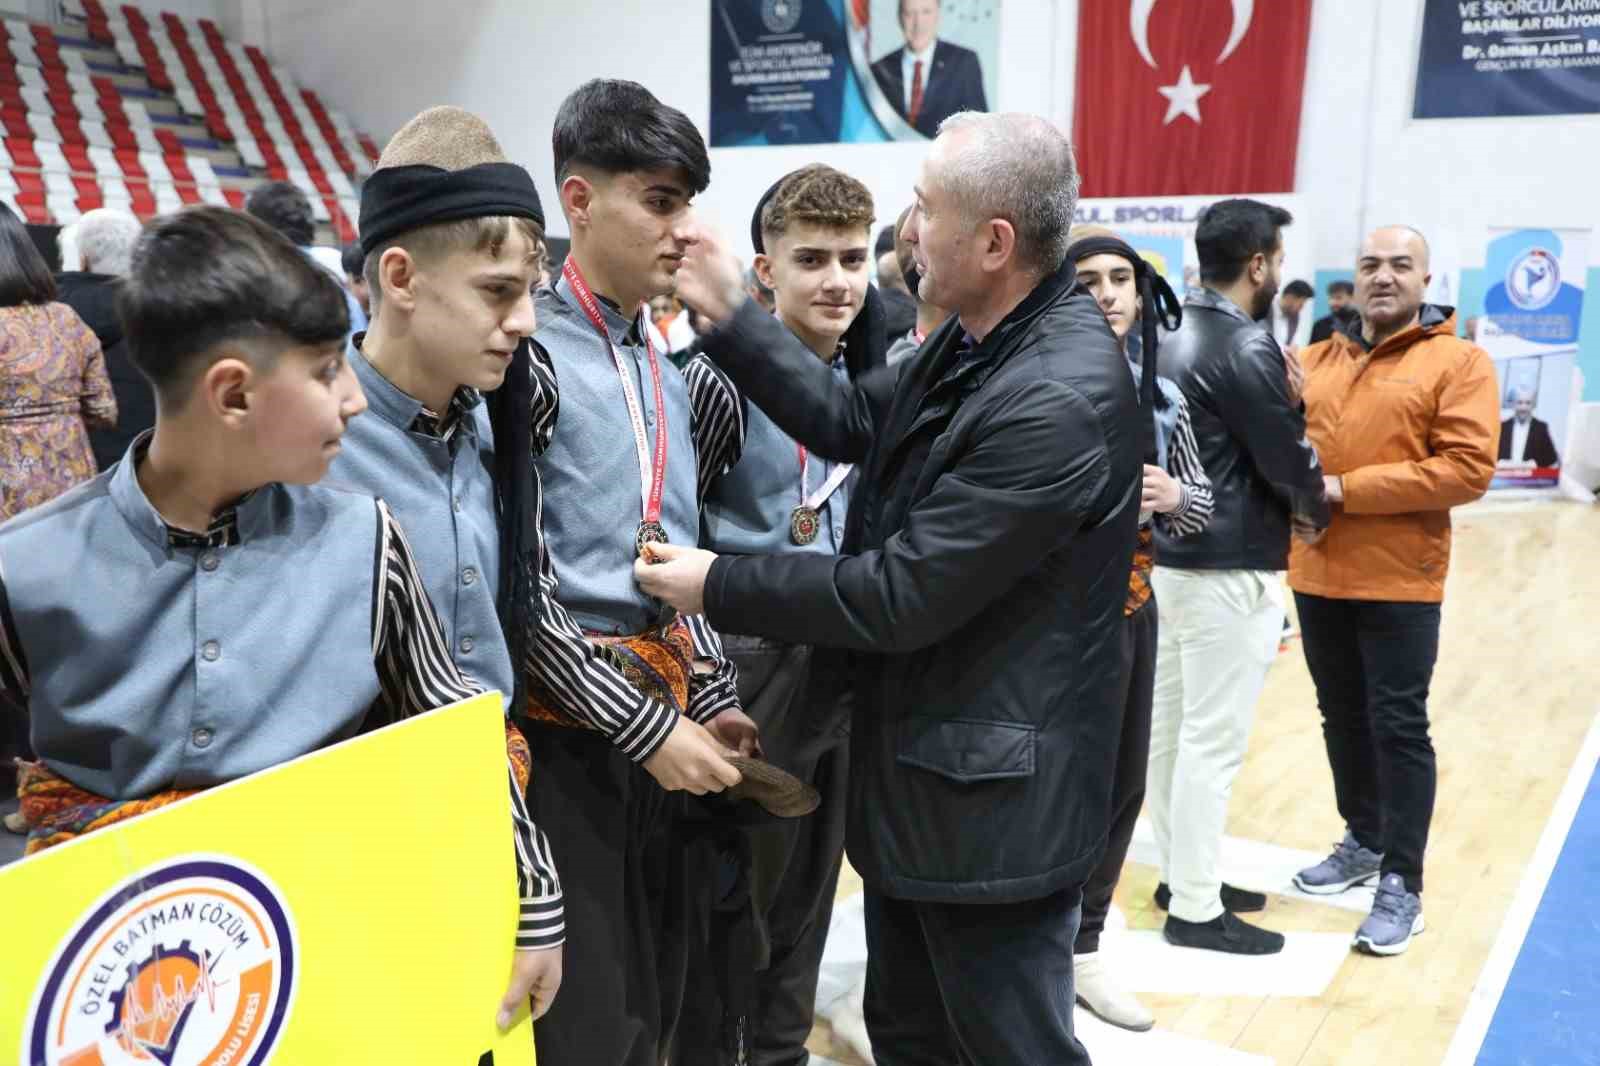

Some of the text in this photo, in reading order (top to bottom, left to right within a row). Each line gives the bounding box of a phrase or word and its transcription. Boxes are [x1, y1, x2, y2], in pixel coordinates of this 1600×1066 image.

[1459, 2, 1480, 18] VE
[1462, 45, 1485, 60] Dr.
[81, 901, 250, 1016] ÖZEL BATMAN ÇÖZÜM
